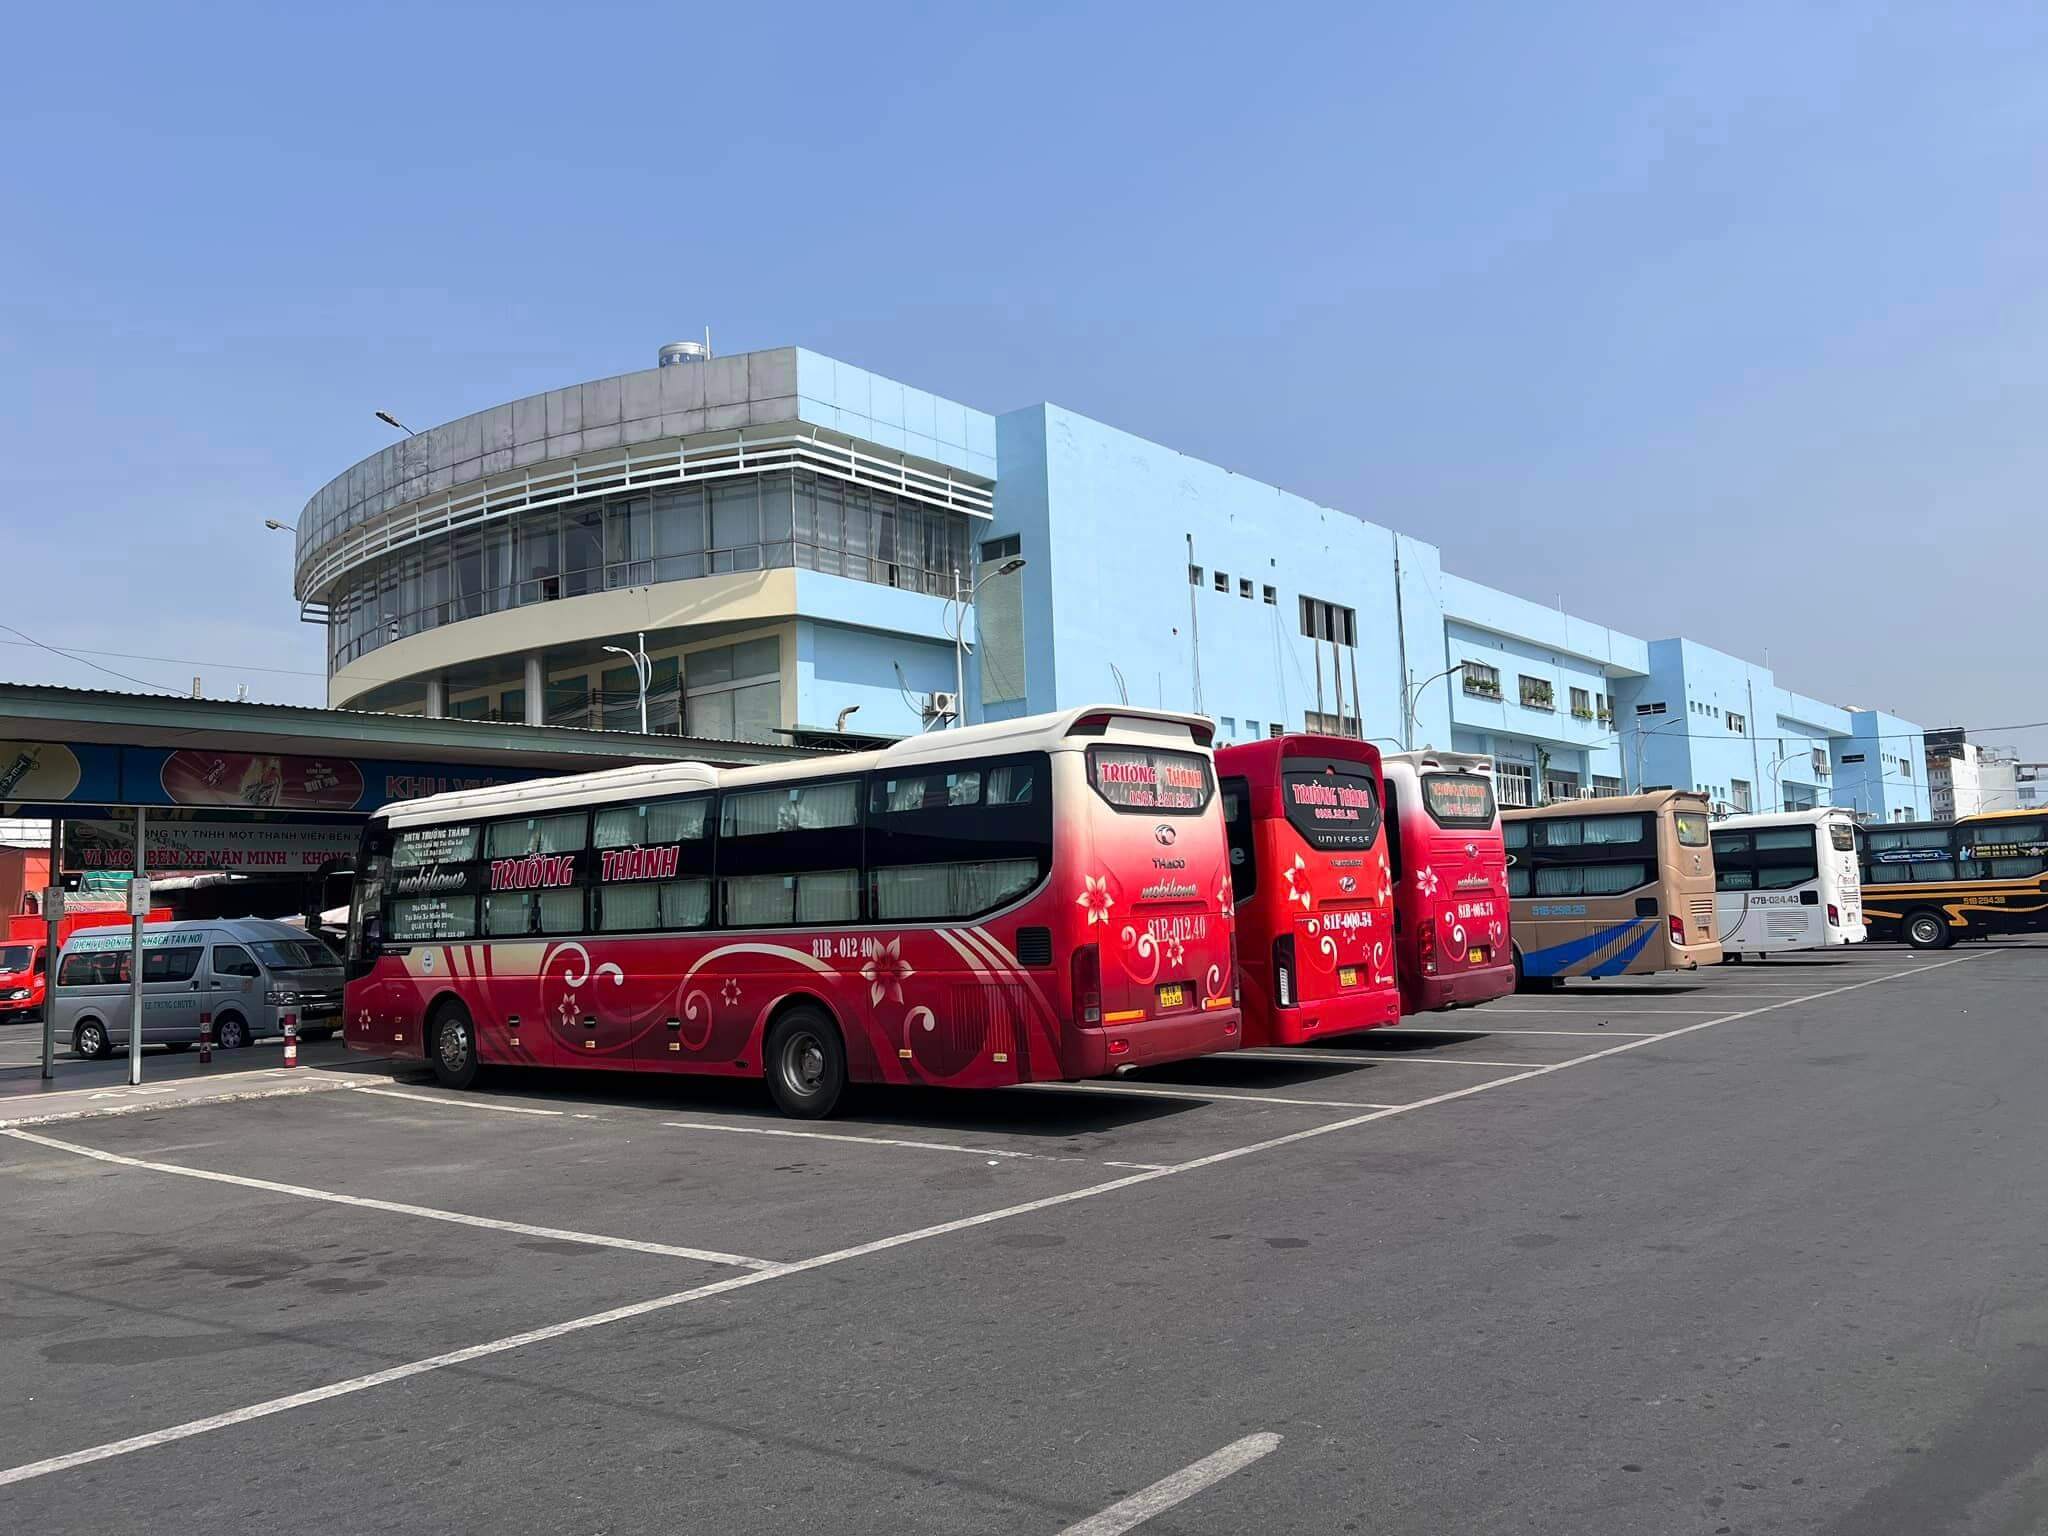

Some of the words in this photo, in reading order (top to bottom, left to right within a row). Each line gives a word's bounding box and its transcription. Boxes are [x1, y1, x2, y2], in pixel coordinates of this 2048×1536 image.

[192, 831, 225, 839] TNHH
[247, 850, 287, 865] MINH
[491, 852, 575, 890] TRƯỜNG
[602, 843, 680, 881] THÀNH
[397, 864, 467, 893] mobihome
